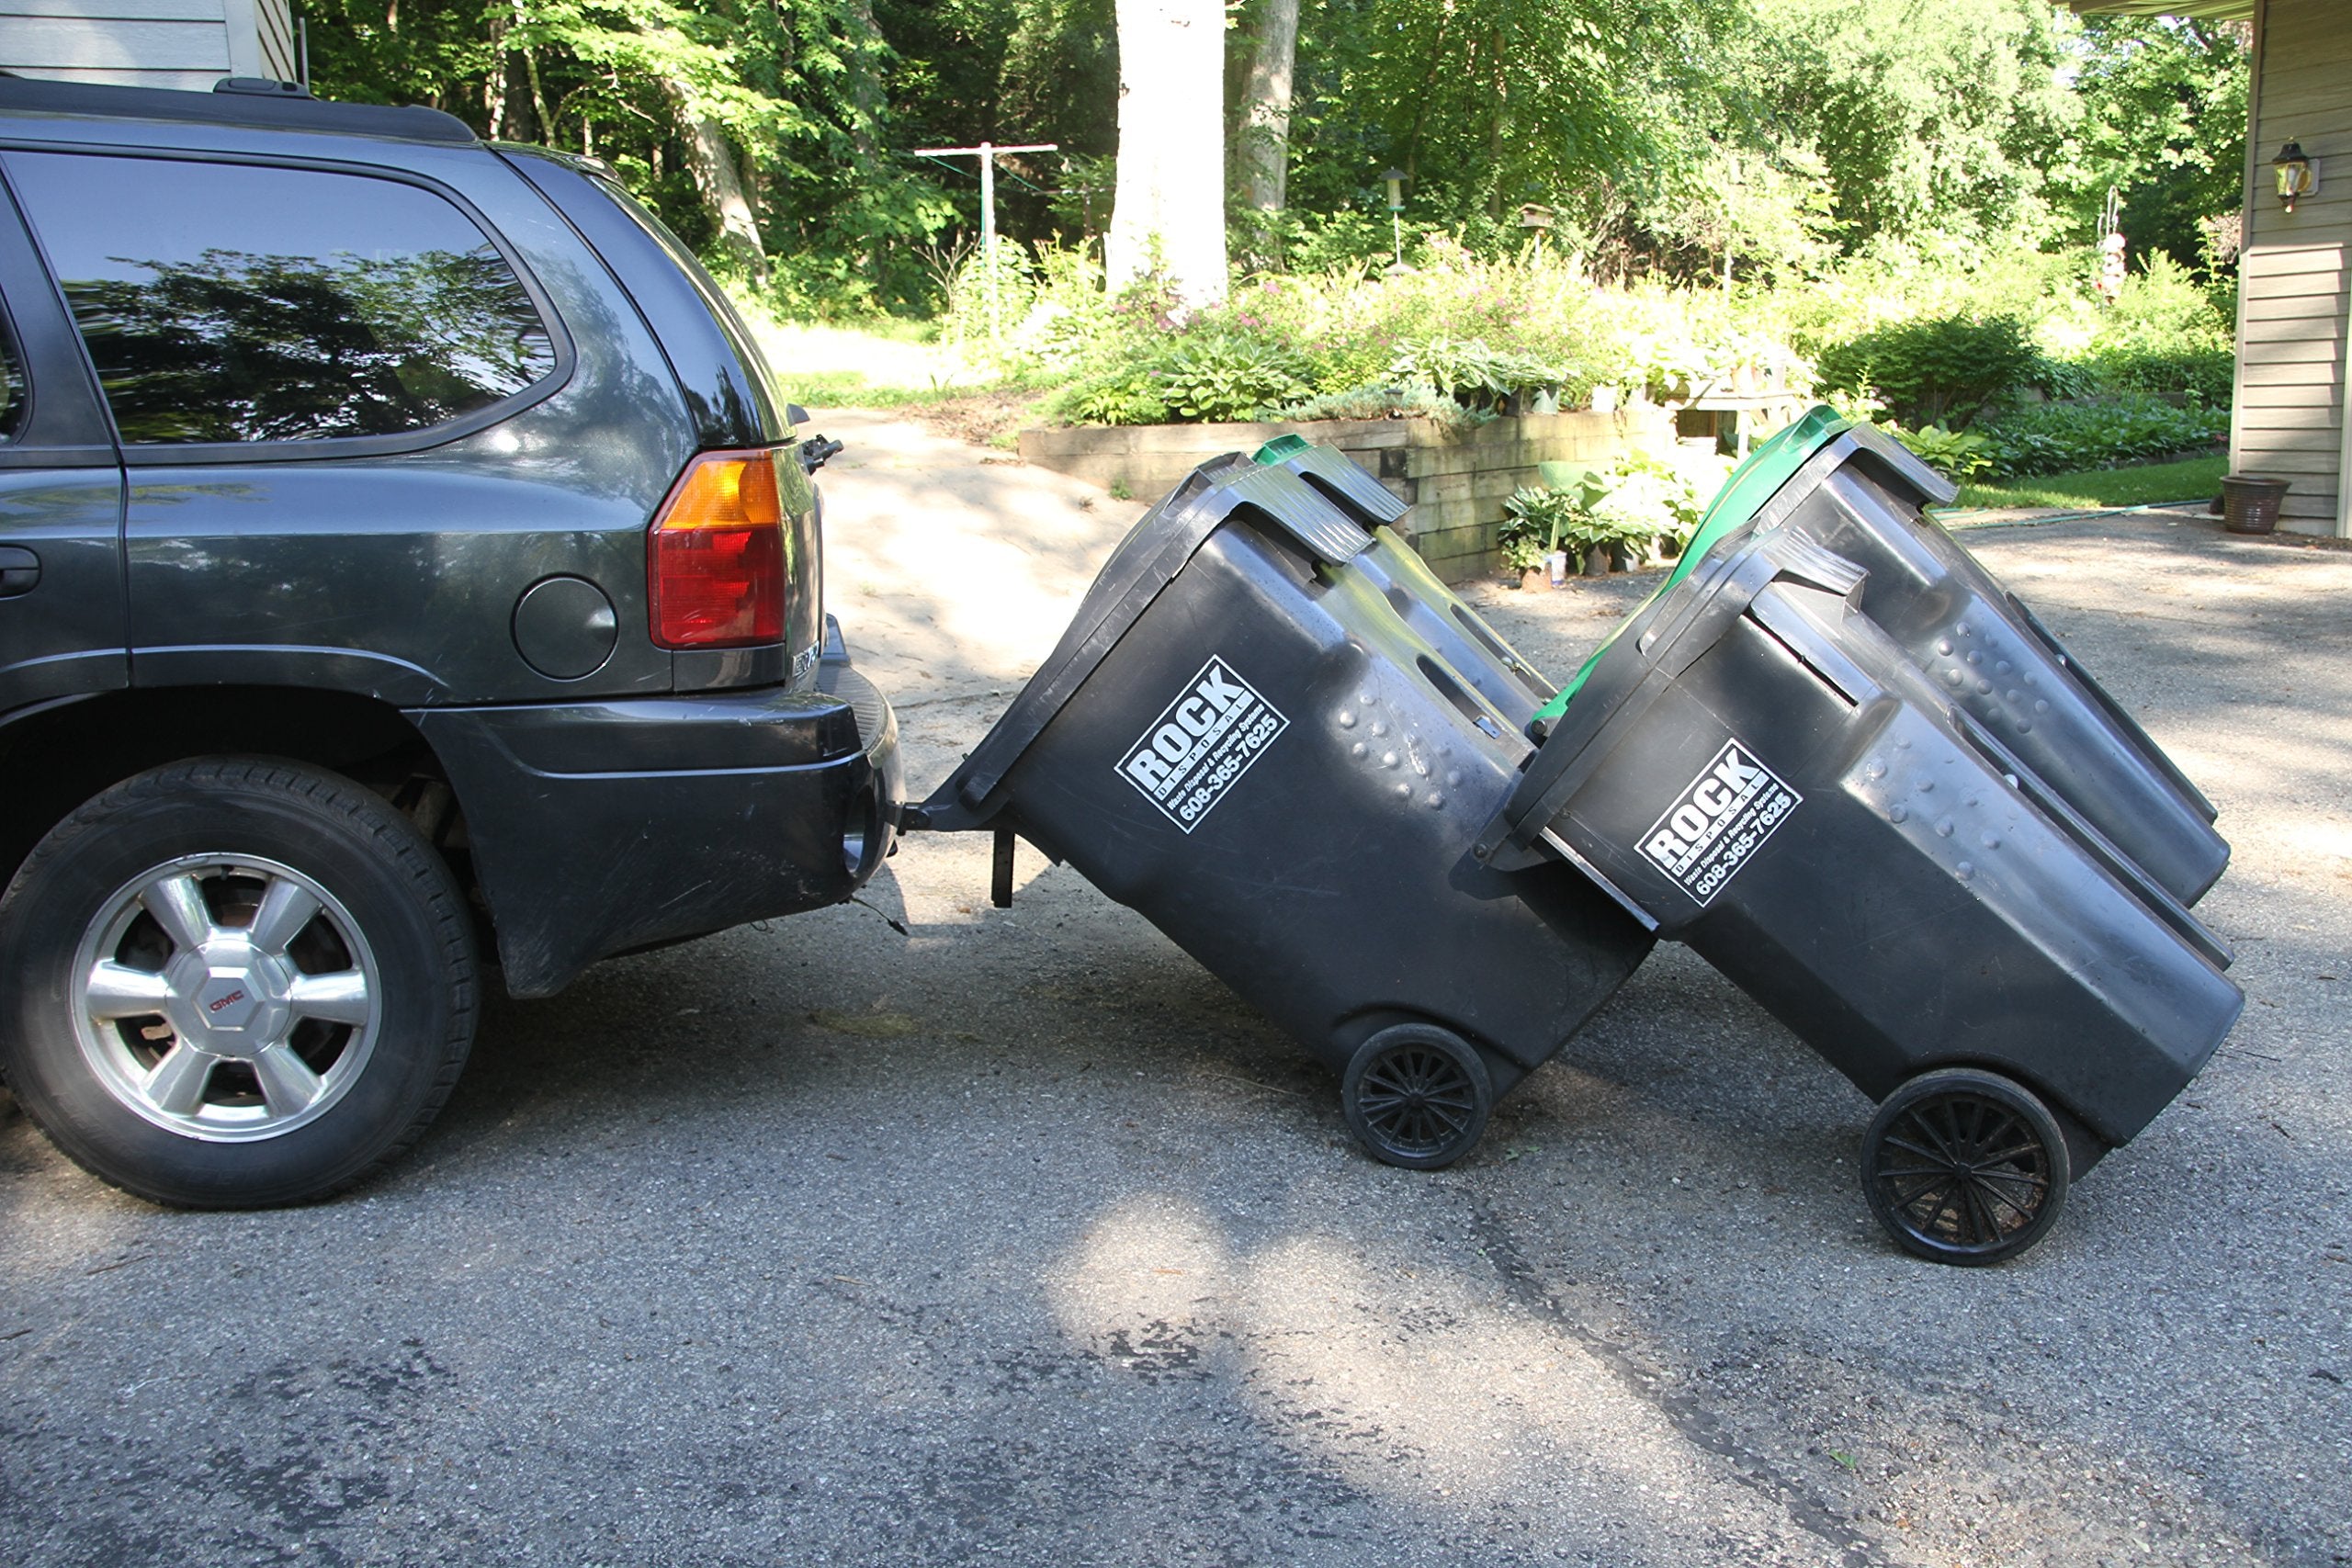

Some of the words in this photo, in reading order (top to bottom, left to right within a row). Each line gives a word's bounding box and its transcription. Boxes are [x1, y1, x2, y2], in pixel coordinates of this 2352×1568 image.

[1126, 665, 1245, 792] ROCK
[1158, 703, 1245, 797] DISPOSAL
[1167, 790, 1186, 810] Waste
[1184, 762, 1210, 792] Disposal
[1207, 758, 1216, 767] &
[1212, 729, 1242, 761] Recycling
[1238, 704, 1265, 732] Systems
[1180, 714, 1278, 821] 608-365-7625
[1645, 748, 1760, 870] ROCK
[1675, 783, 1759, 874] DISPOSAL
[1684, 866, 1702, 886] Waste
[1700, 840, 1725, 868] Disposal
[1723, 836, 1731, 844] &
[1727, 807, 1757, 839] Recycling
[1753, 783, 1779, 810] Systems
[1696, 792, 1792, 895] 608-365-7625
[209, 990, 244, 1012] GMC
